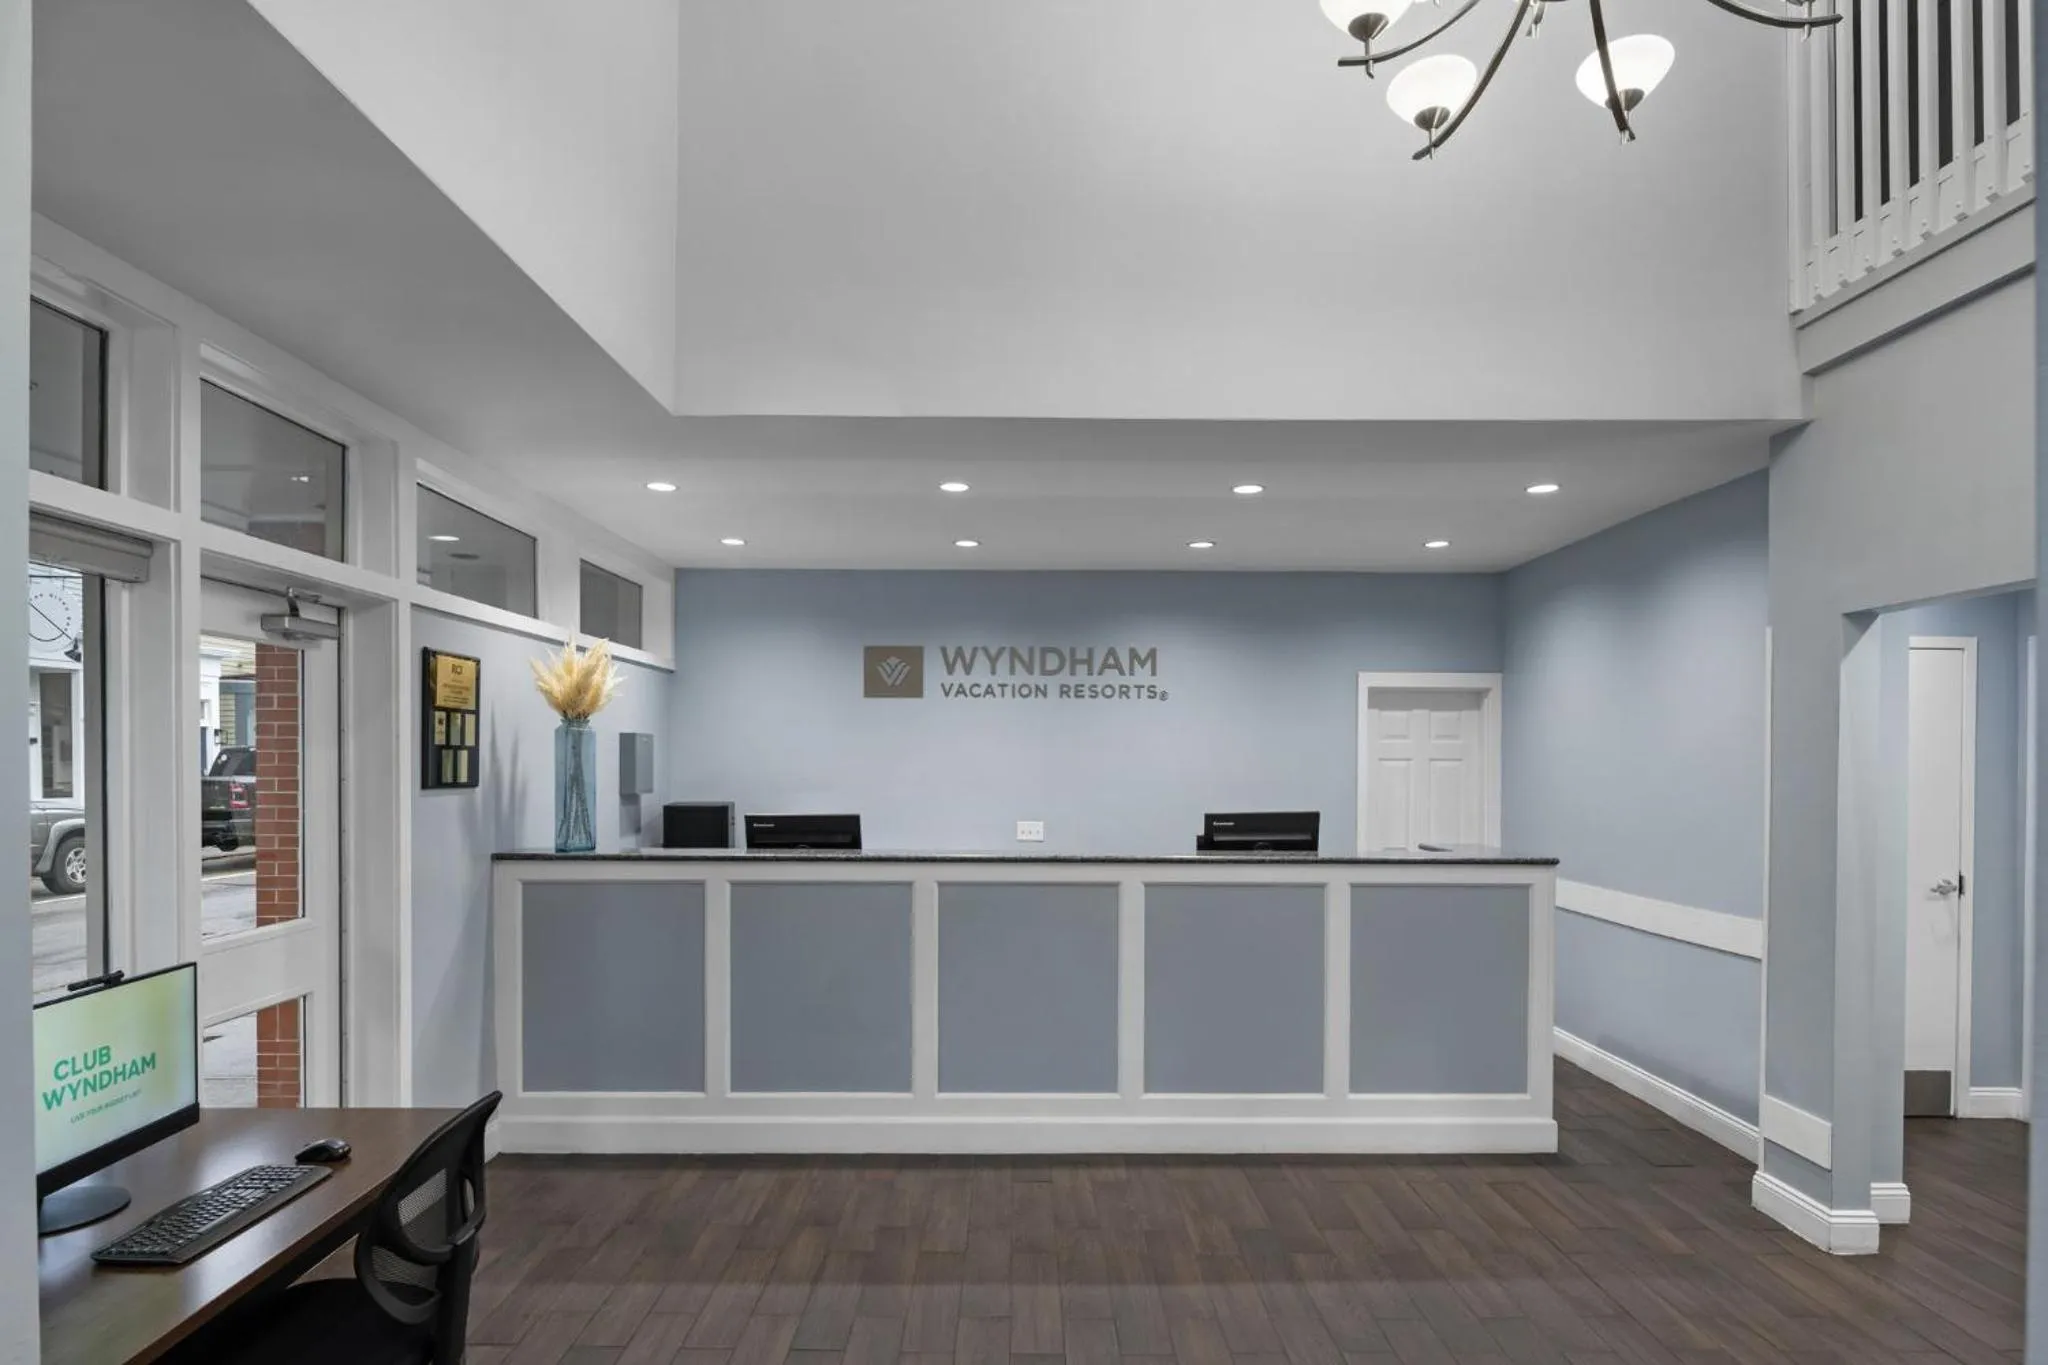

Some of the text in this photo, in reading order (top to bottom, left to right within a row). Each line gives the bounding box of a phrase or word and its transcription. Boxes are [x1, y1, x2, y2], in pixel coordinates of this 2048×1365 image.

[940, 646, 1158, 676] WYNDHAM
[940, 683, 1048, 698] VACATION
[54, 1045, 111, 1080] CLUB
[42, 1052, 156, 1110] WYNDHAM
